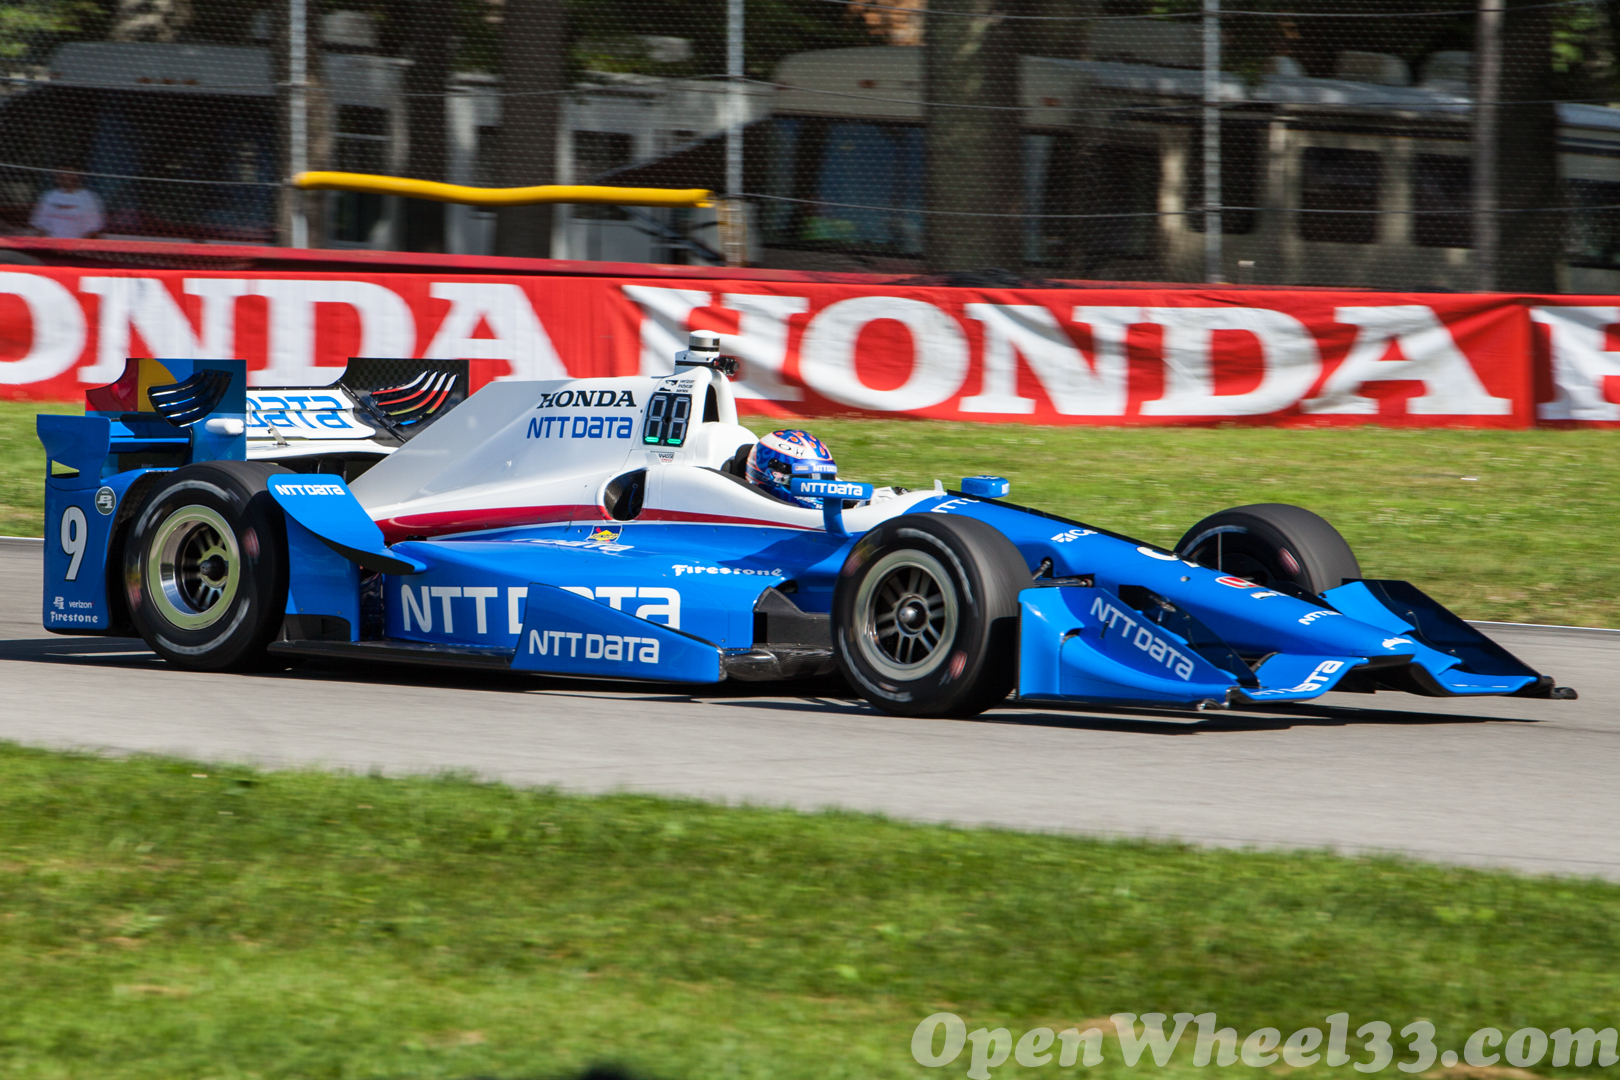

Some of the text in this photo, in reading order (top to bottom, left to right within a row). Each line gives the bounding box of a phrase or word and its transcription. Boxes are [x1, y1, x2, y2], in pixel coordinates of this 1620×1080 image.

[621, 284, 1512, 416] HONDA
[537, 391, 637, 409] HONDA
[527, 416, 570, 439] NTT
[275, 484, 303, 495] NTT
[800, 482, 827, 493] NTT
[61, 505, 88, 581] 9
[671, 564, 782, 577] Firestone
[50, 611, 98, 623] Firestone
[401, 584, 498, 634] NTT
[1089, 597, 1138, 638] NTT
[528, 629, 583, 658] NTT
